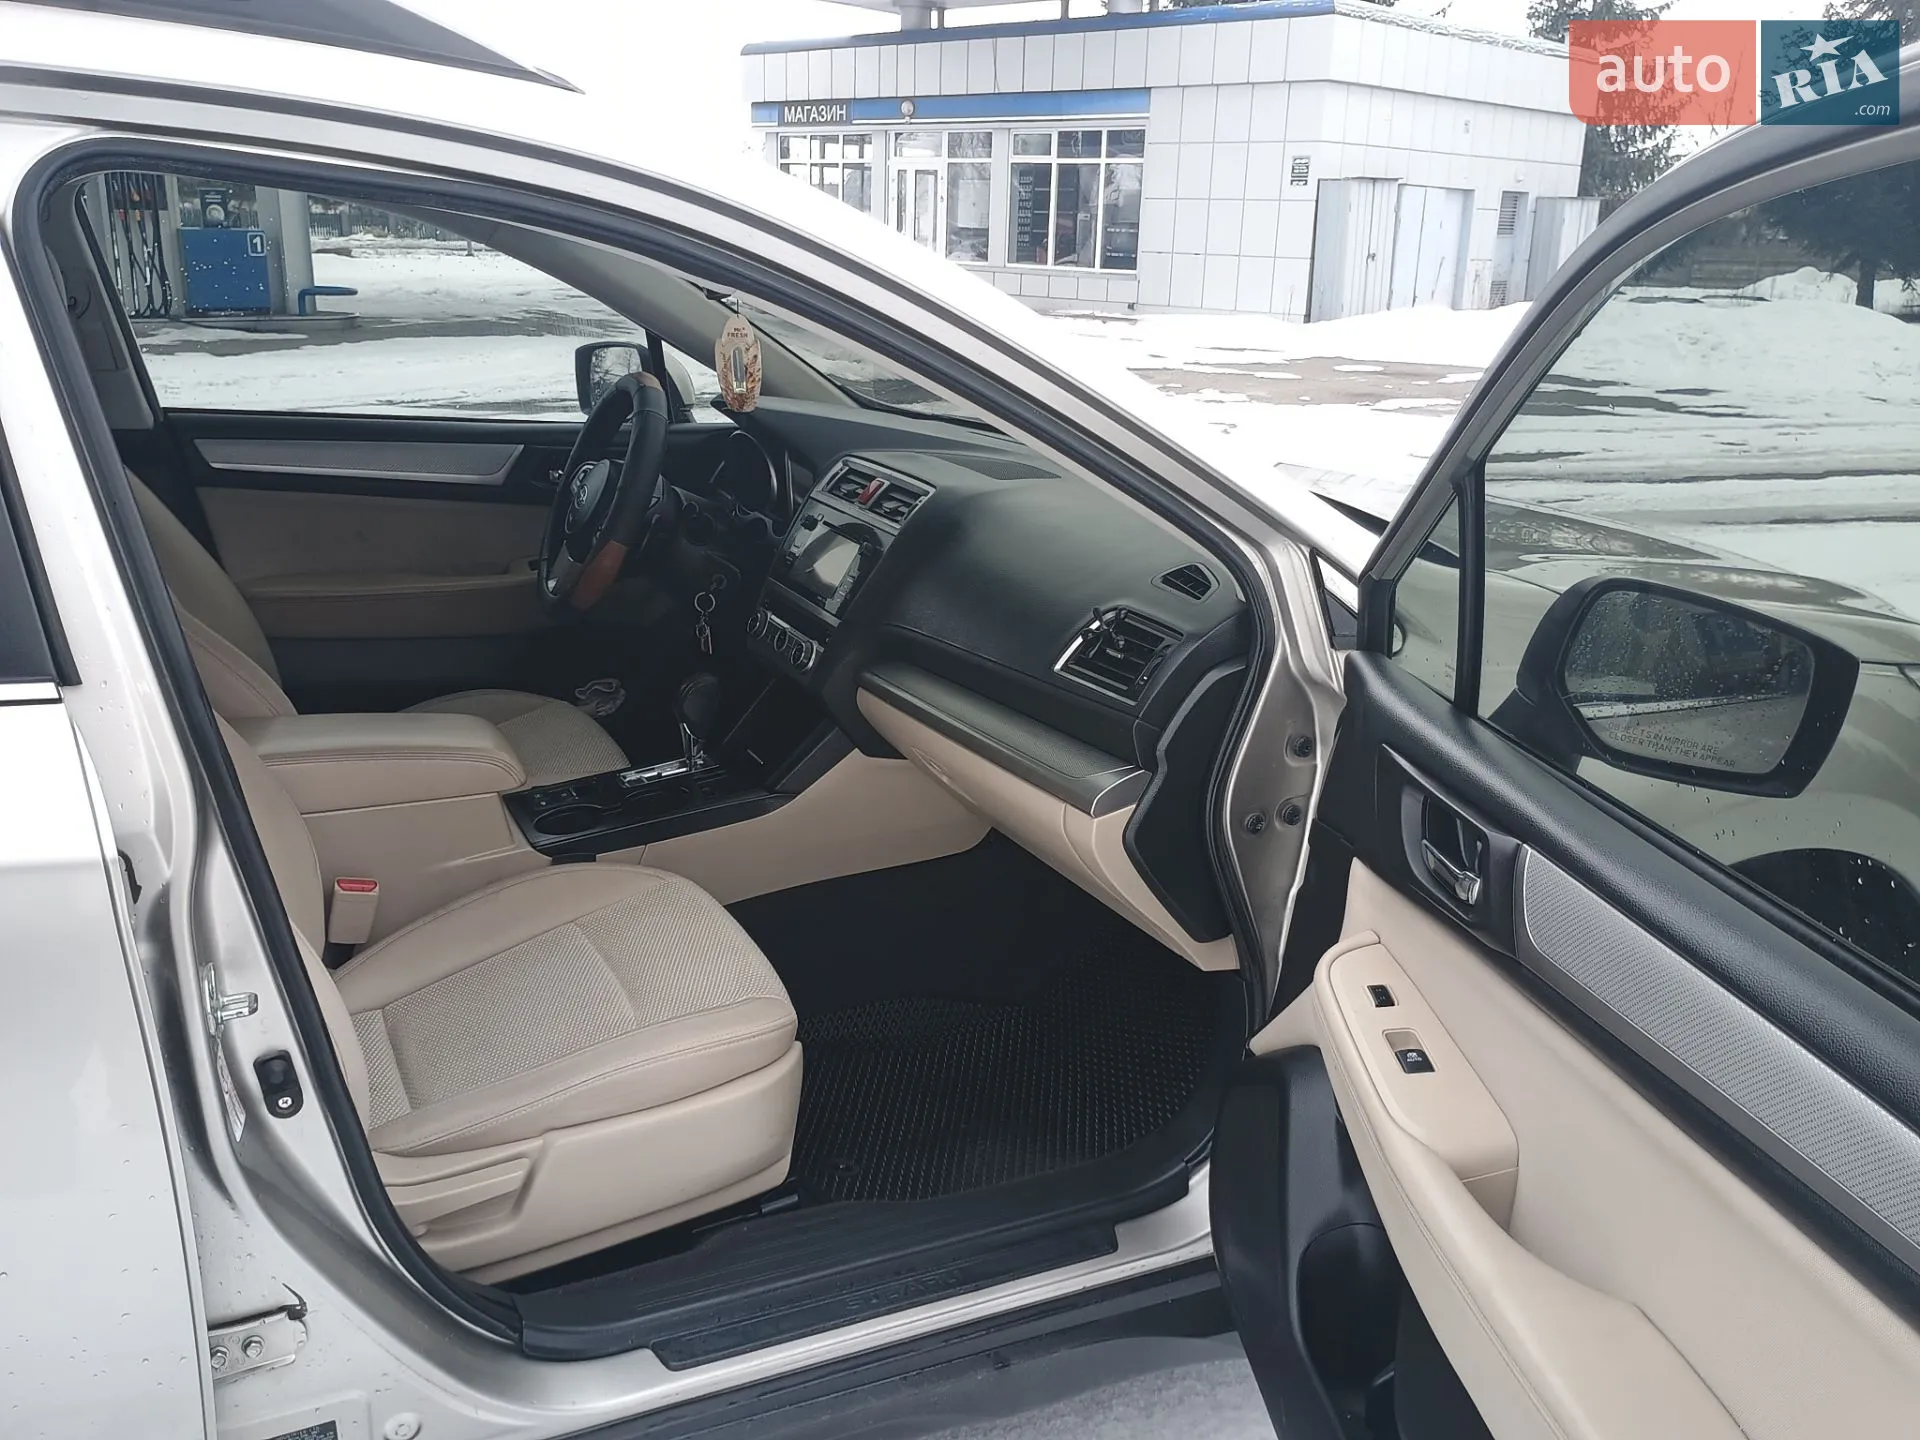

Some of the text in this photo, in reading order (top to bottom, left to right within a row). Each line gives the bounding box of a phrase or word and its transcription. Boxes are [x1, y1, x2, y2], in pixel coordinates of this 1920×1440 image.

[784, 104, 846, 123] МАГАЗИН
[253, 236, 261, 252] 1
[1608, 721, 1652, 739] OBJECTS
[1663, 735, 1698, 750] MIRROR
[1701, 744, 1719, 756] ARE
[1609, 731, 1736, 768] CLOSER THAN THEY APPEAR
